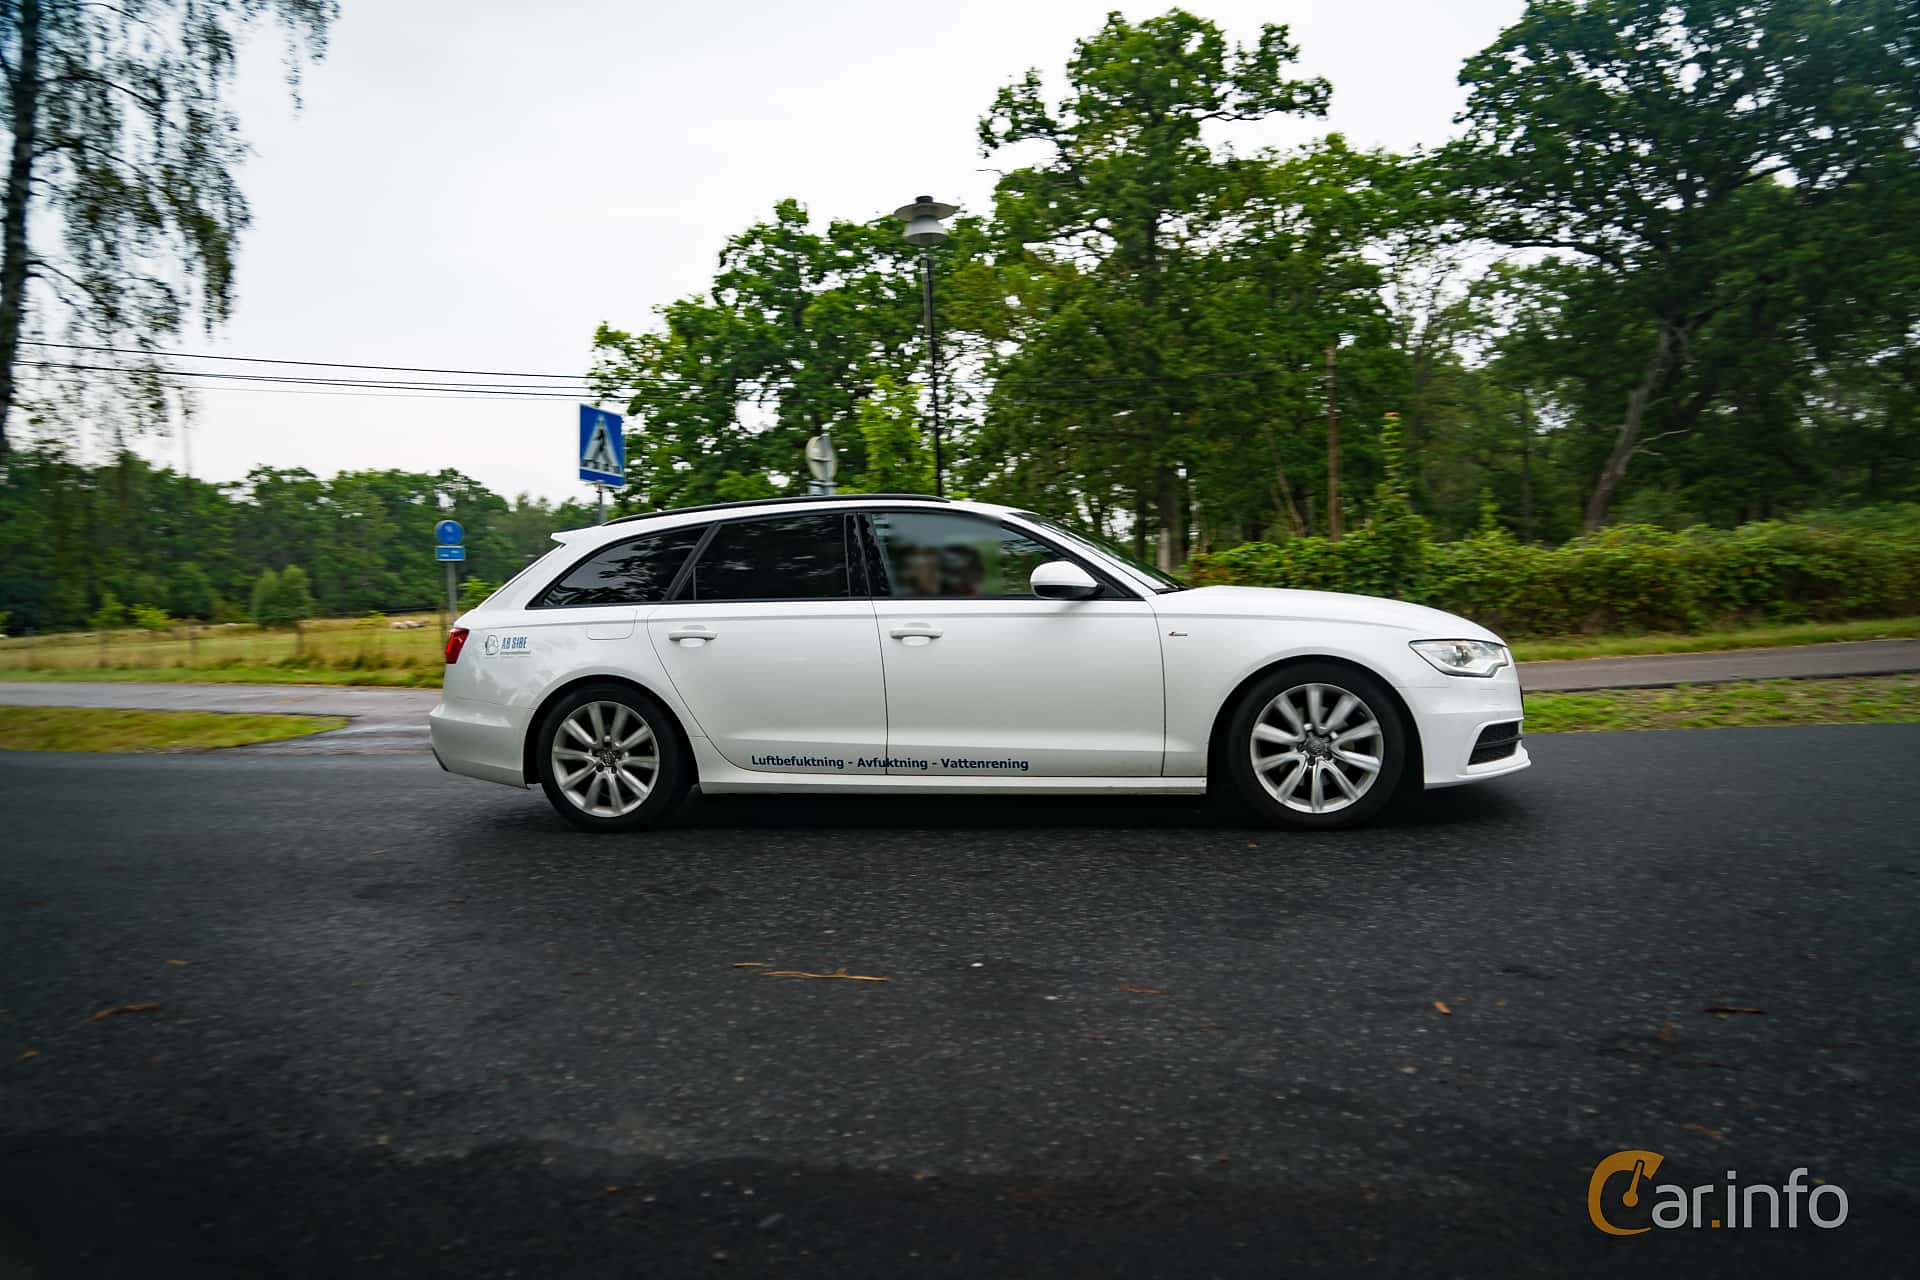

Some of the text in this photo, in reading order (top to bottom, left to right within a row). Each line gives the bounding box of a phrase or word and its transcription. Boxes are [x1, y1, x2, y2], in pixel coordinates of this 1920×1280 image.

[751, 755, 844, 769] Luftbefuktning
[857, 757, 928, 770] Avfuktning
[940, 758, 1029, 771] Vattenrening
